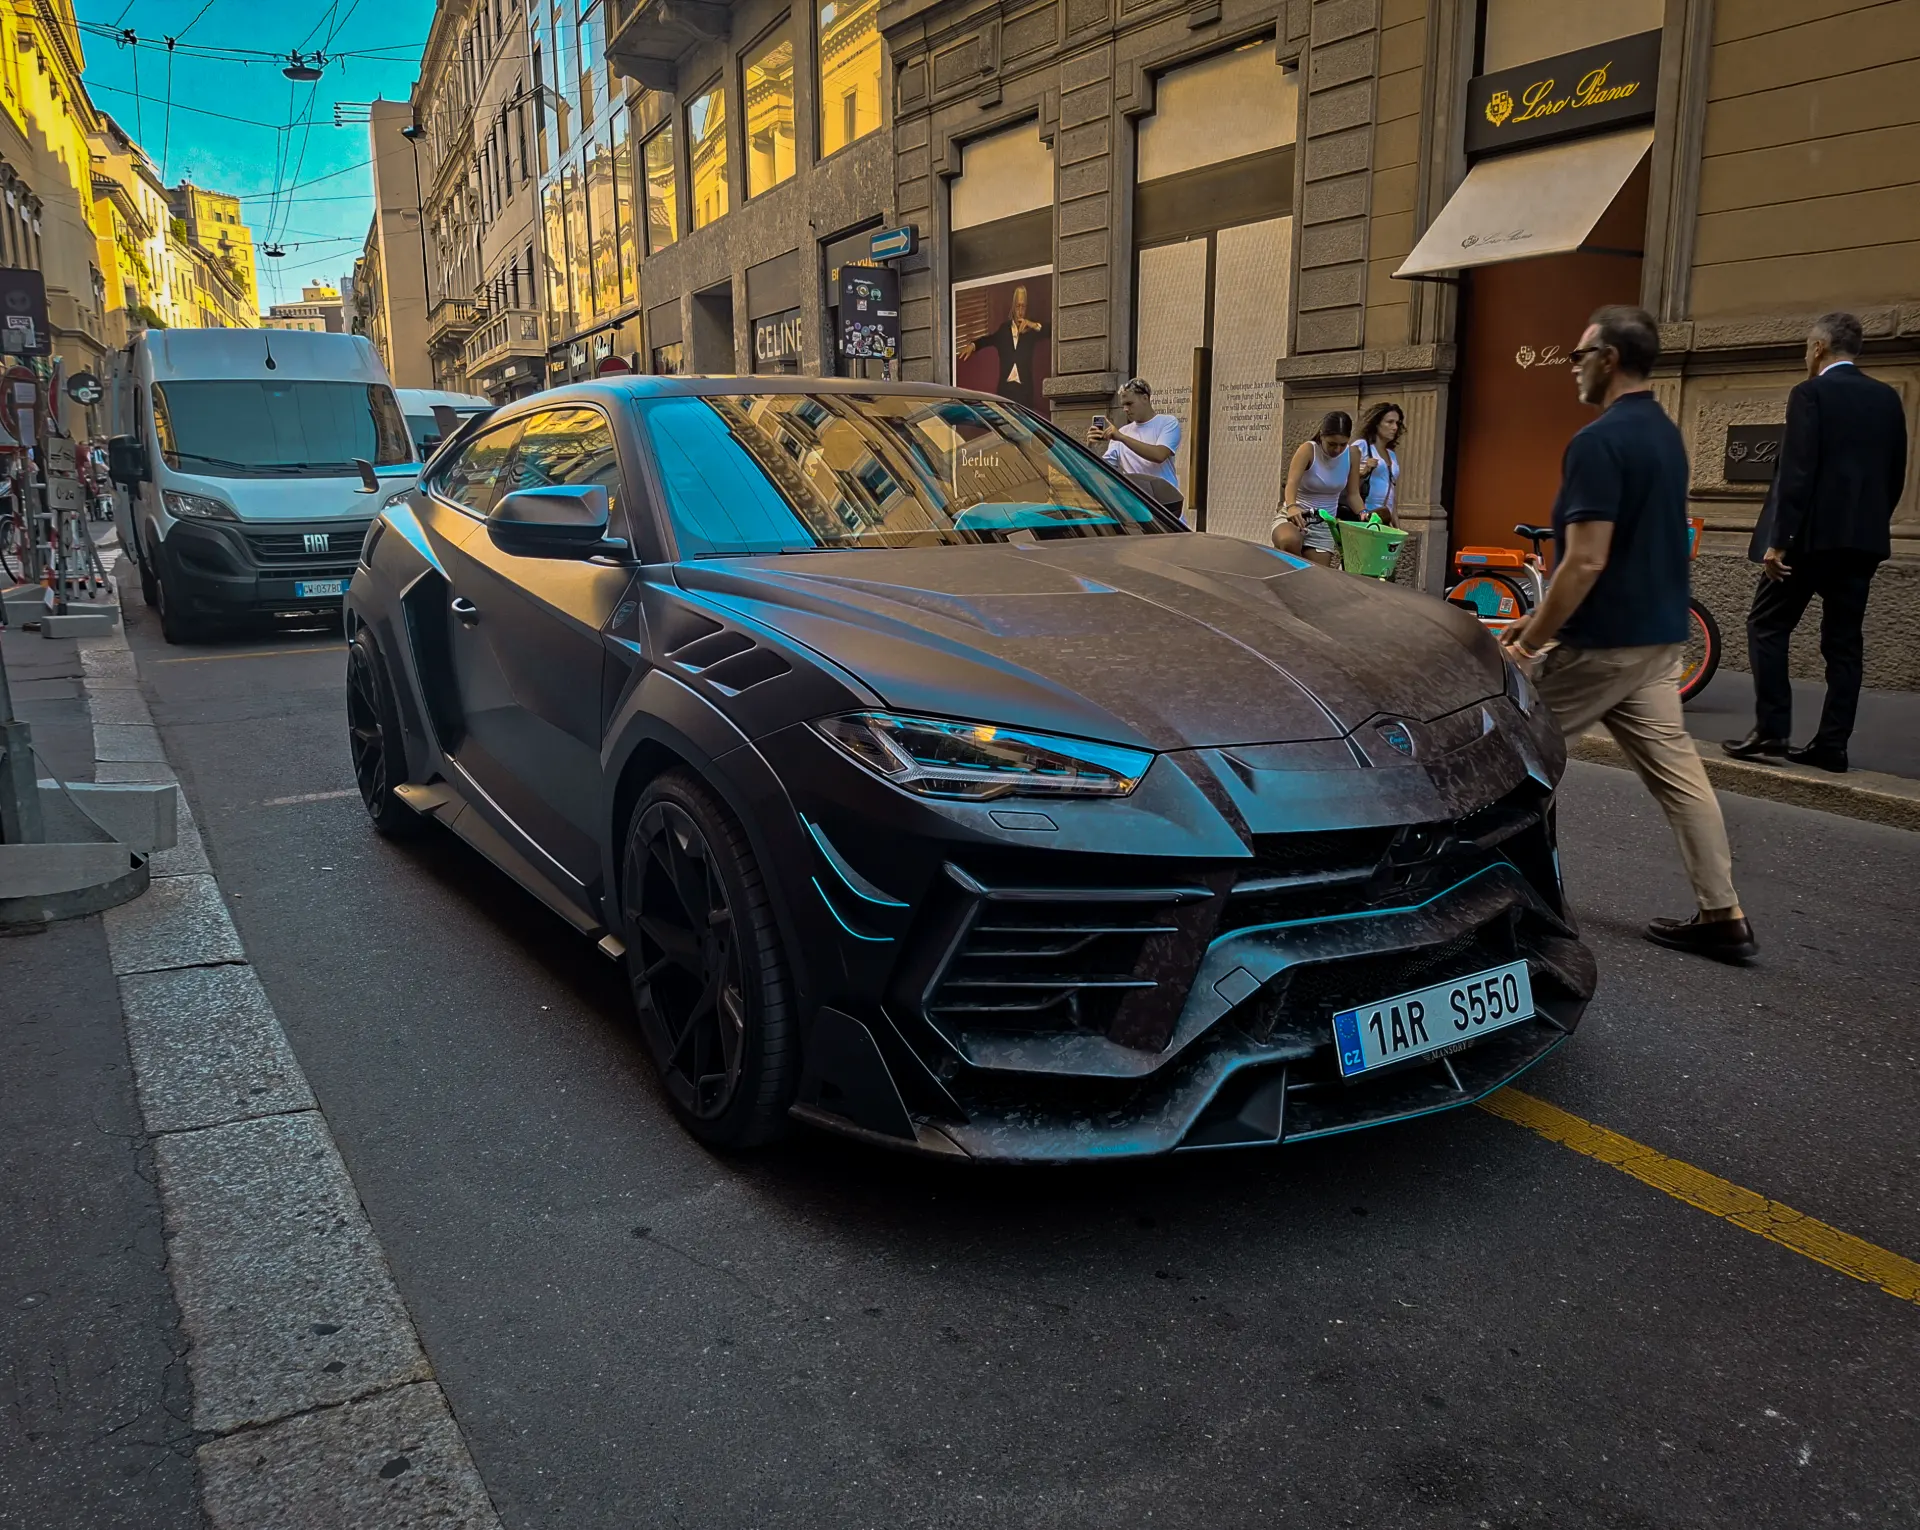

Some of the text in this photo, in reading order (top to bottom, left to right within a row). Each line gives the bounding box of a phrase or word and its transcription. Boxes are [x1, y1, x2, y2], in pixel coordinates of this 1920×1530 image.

[1512, 61, 1640, 123] Loro Piana
[756, 317, 802, 360] CELINE
[1535, 345, 1569, 367] Loro
[961, 448, 999, 467] Berluti
[1746, 440, 1778, 463] Lor
[303, 533, 329, 553] FIAT
[1368, 973, 1519, 1056] 1AR S550
[1344, 1050, 1361, 1066] CZ
[1431, 1041, 1467, 1060] MANSORY
